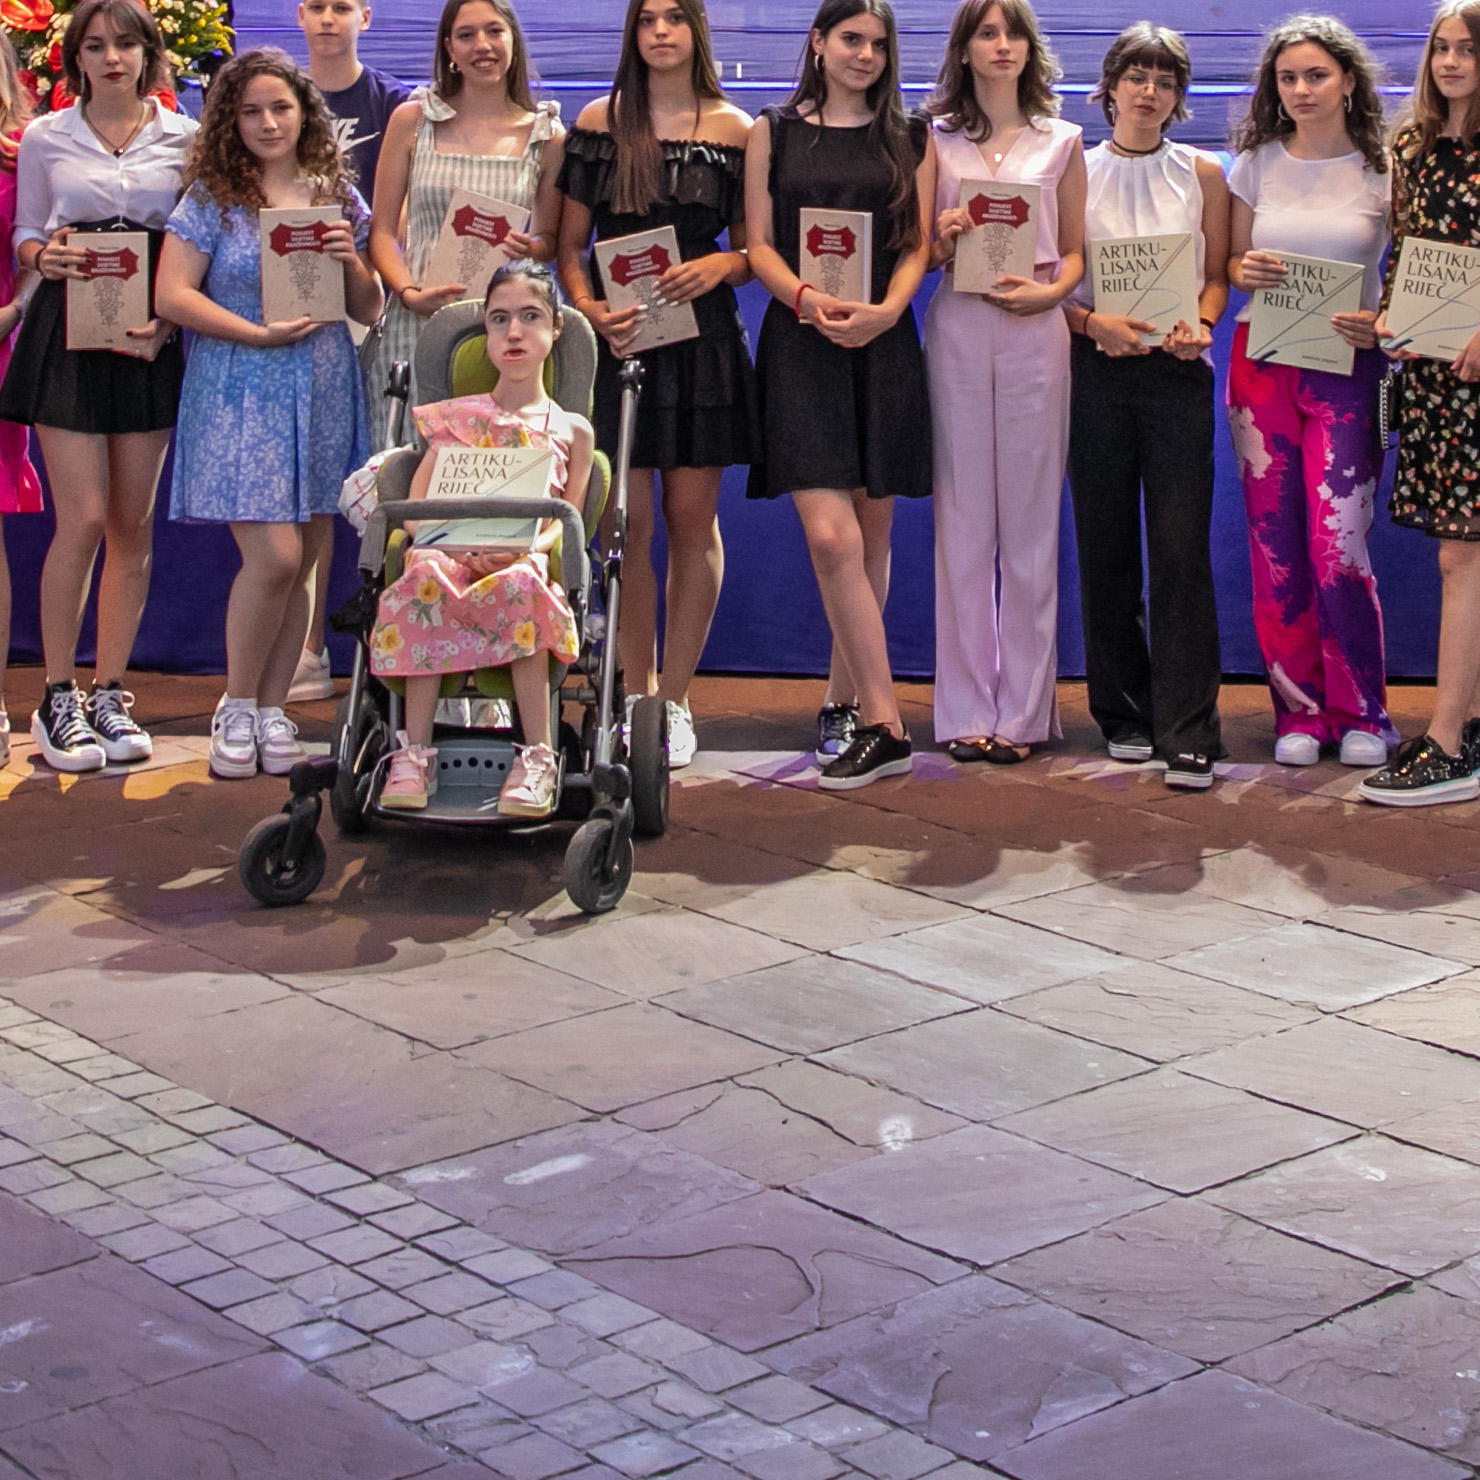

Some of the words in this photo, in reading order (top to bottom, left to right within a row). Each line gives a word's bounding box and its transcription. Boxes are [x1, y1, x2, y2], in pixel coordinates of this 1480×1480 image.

[1100, 242, 1167, 259] ARTIKU-
[1100, 258, 1159, 276] LISANA
[1280, 261, 1337, 281] TIKU-
[1407, 261, 1468, 285] LISANA
[1102, 274, 1143, 293] RIJEČ
[1403, 279, 1448, 300] RIJEČ
[1263, 292, 1306, 311] RIJEČ
[444, 453, 522, 466] ARTIKU-
[441, 466, 507, 480] LISANA
[437, 479, 484, 495] RIJEČ
